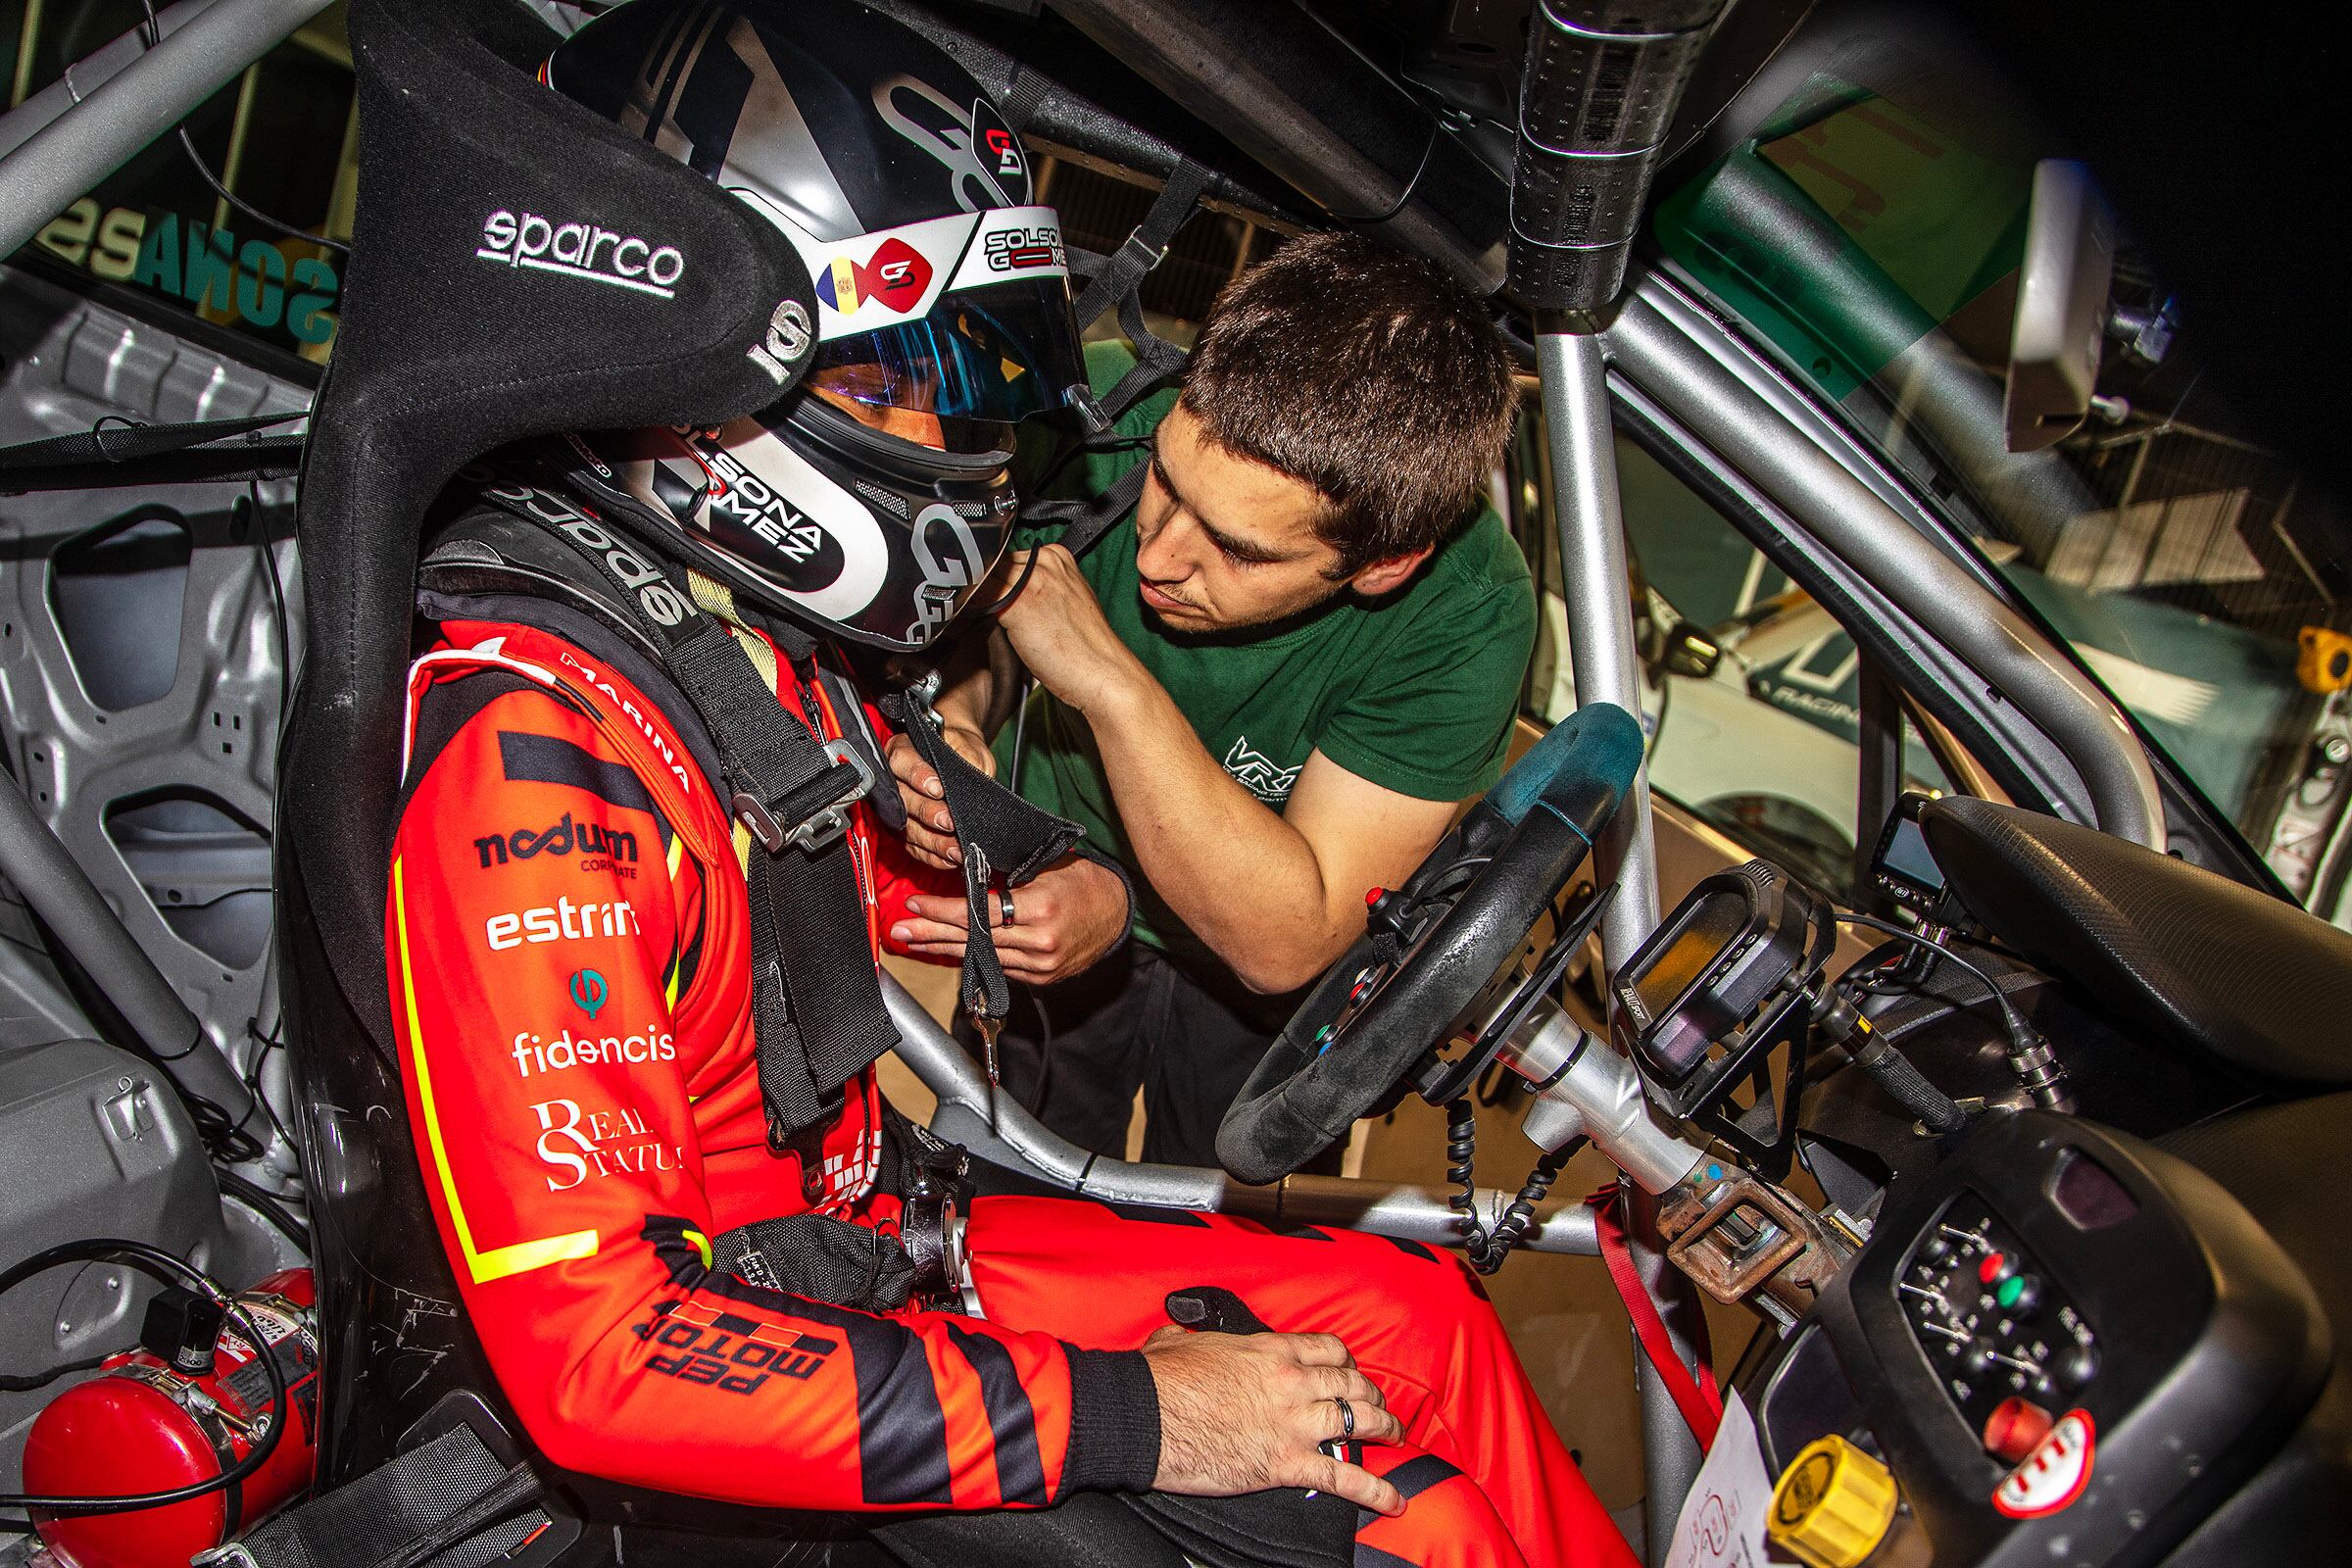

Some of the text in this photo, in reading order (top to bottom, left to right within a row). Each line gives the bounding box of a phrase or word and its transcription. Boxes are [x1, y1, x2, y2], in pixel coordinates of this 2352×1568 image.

[483, 208, 684, 286] sparco
[560, 651, 690, 794] MARINA
[1237, 777, 1269, 796] RACING
[473, 810, 639, 869] nodum
[645, 1354, 770, 1396] PEP
